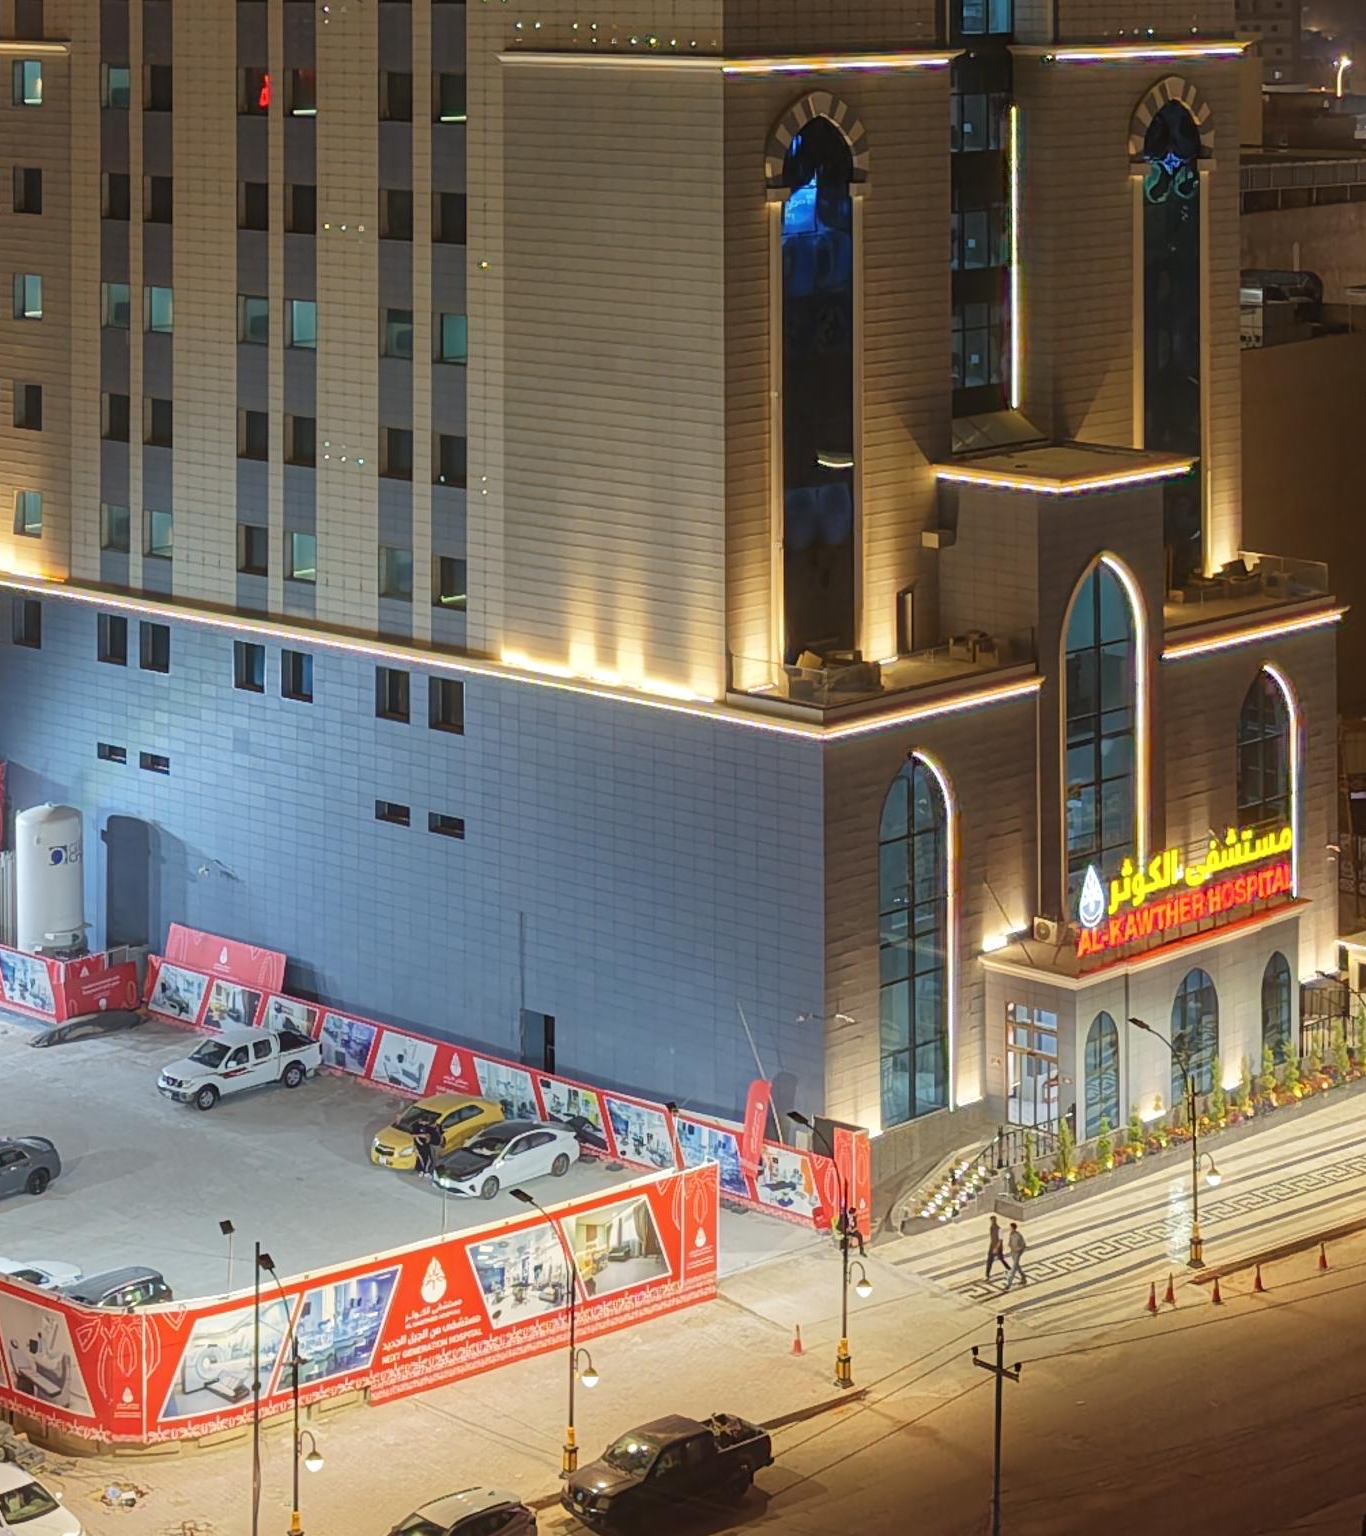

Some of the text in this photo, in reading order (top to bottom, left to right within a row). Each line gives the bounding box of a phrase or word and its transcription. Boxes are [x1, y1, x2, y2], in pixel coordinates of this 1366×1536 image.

[1076, 862, 1294, 959] AL-KAWTHER HOSPITAL
[1108, 826, 1293, 917] مستشفى الكوثر
